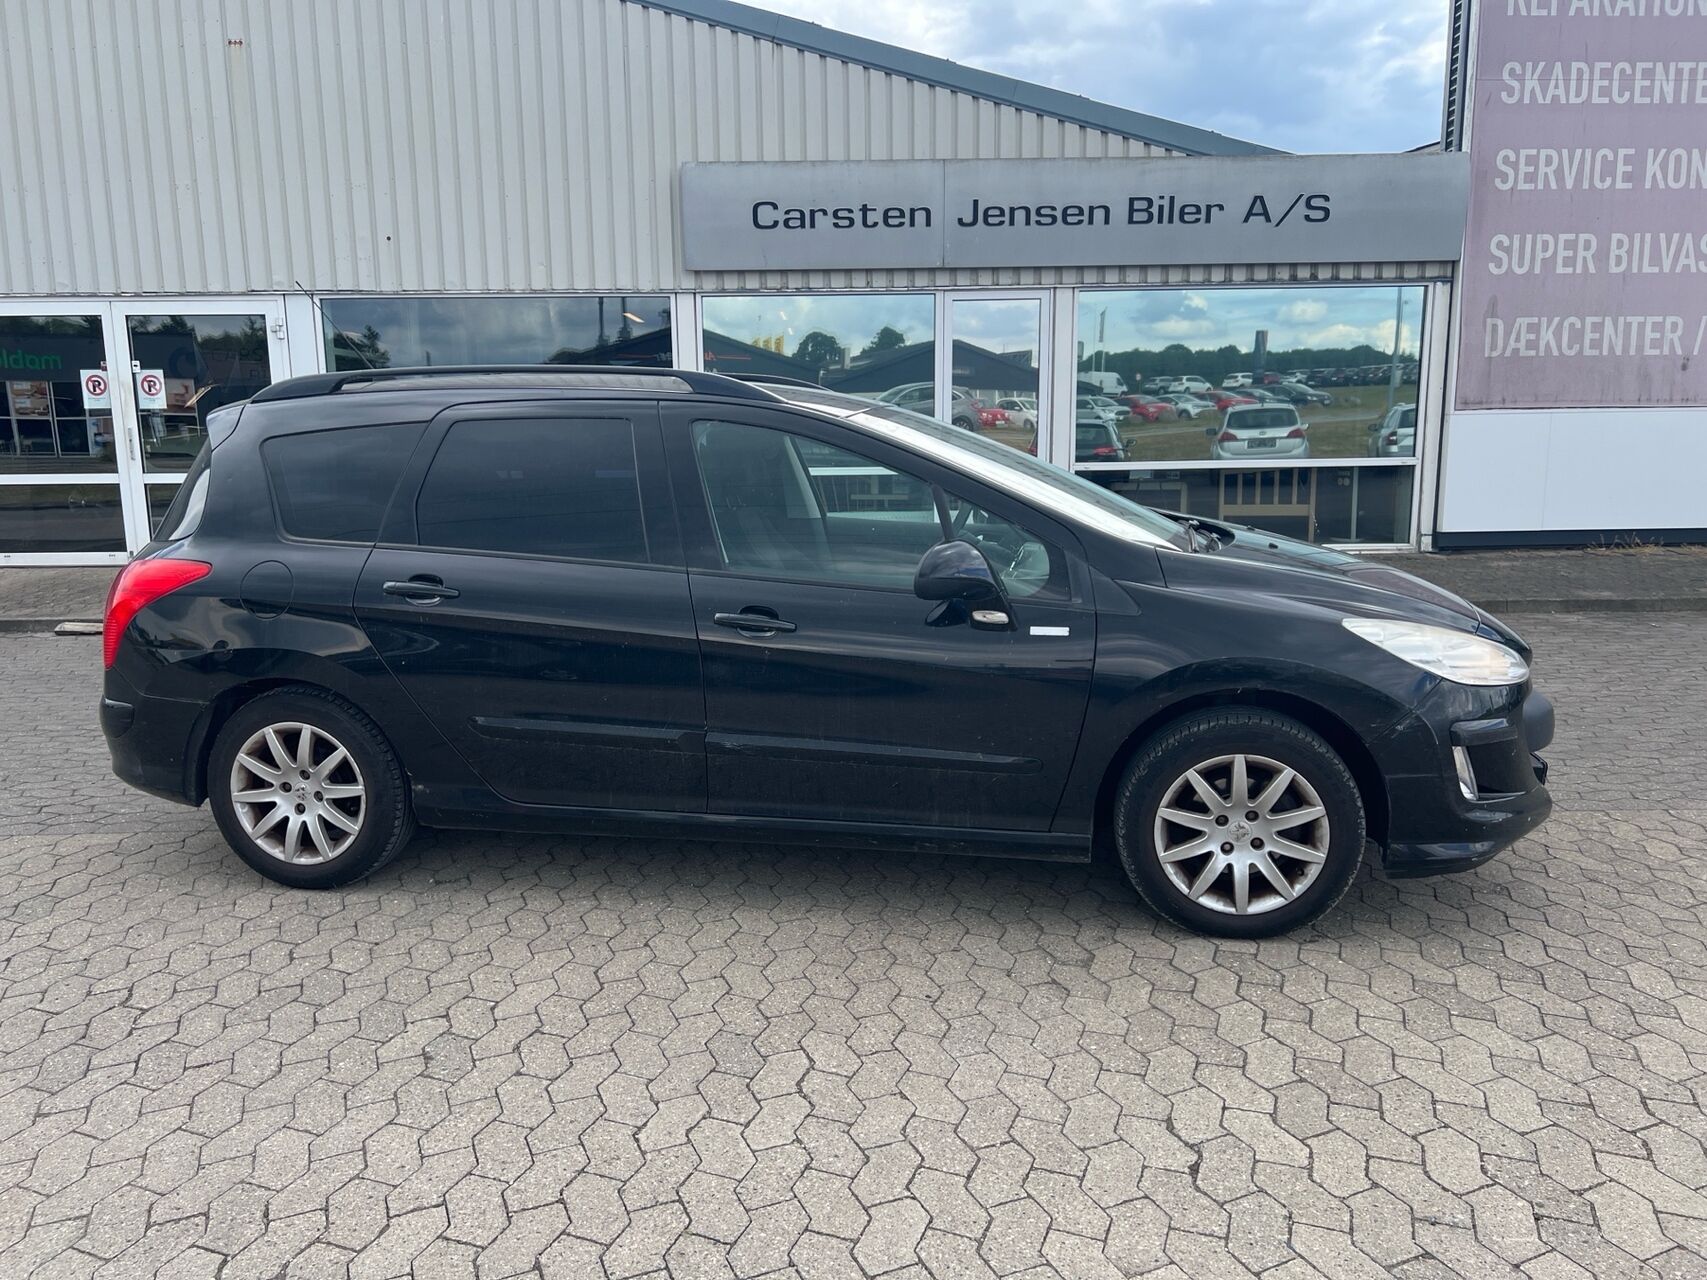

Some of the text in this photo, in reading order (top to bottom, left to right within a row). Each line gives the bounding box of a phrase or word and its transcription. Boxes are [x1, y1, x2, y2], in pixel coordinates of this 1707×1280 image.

[1500, 61, 1707, 104] SKADECENTE
[1494, 148, 1707, 190] SERVICE KON
[752, 193, 1331, 230] Carsten Jensen Biler A/S
[1488, 233, 1597, 275] SUPER
[1484, 315, 1684, 358] DÆKCENTER
